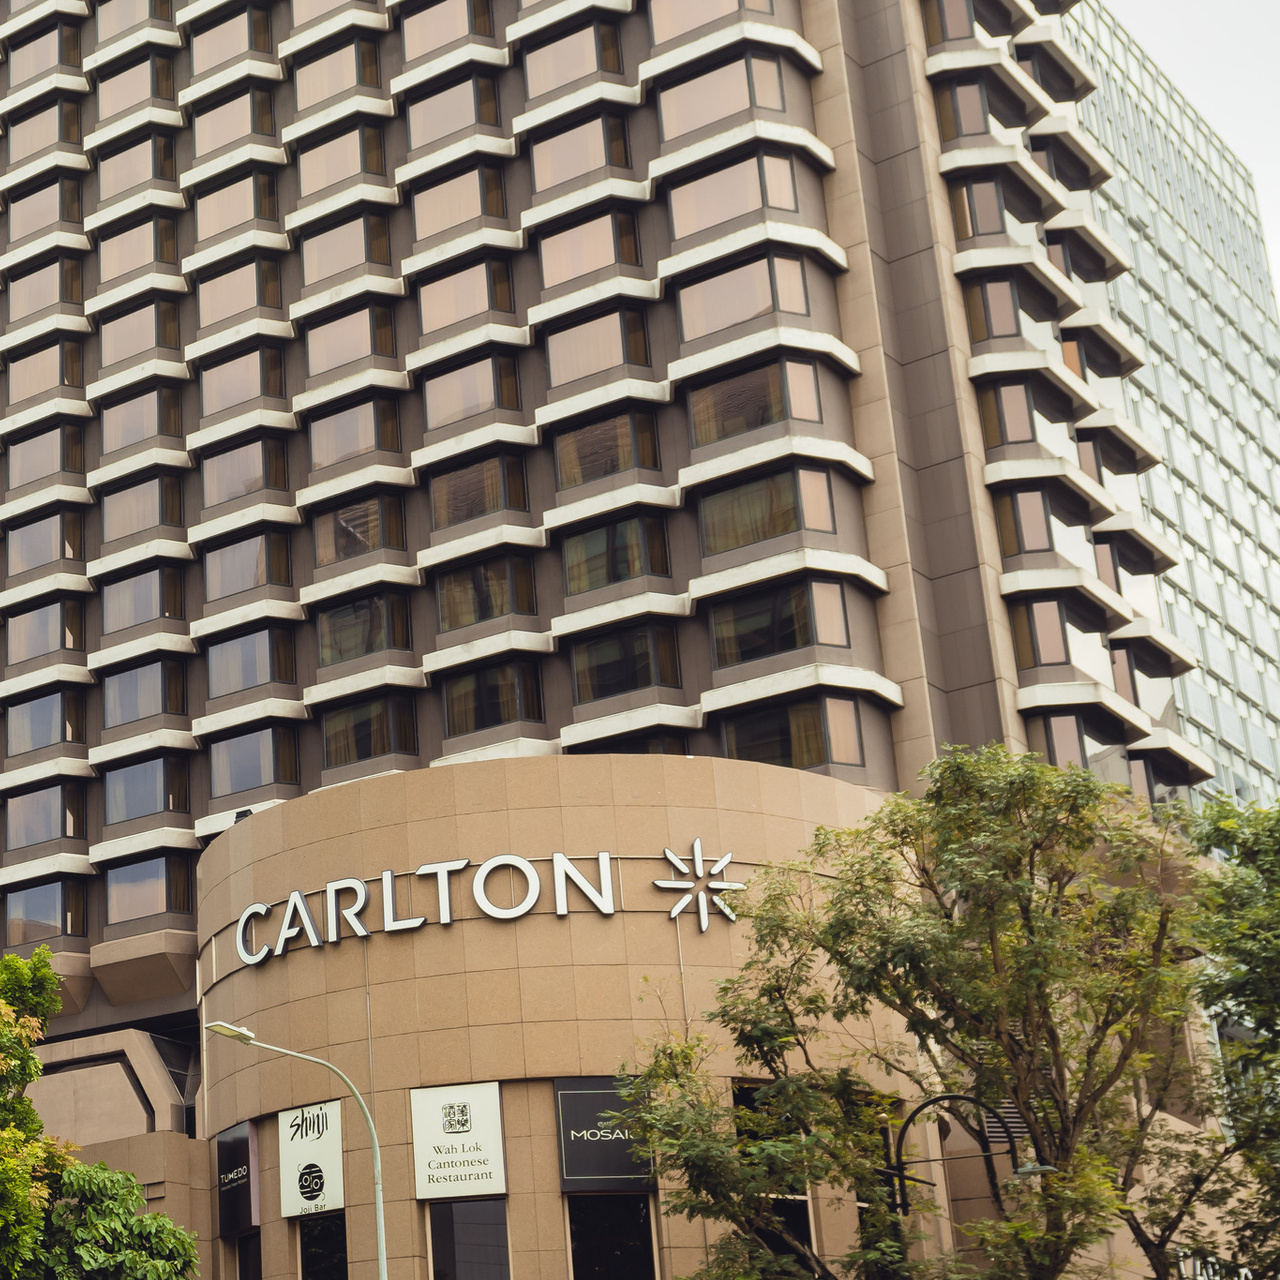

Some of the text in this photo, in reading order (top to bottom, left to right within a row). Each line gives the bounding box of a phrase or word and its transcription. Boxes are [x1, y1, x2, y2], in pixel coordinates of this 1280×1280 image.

[235, 851, 615, 966] CARLTON
[570, 1129, 634, 1141] MOSAI
[432, 1142, 482, 1155] Wah Lok
[428, 1158, 489, 1170] Cantonese
[427, 1171, 493, 1184] Restaurant
[314, 1203, 326, 1212] Bar
